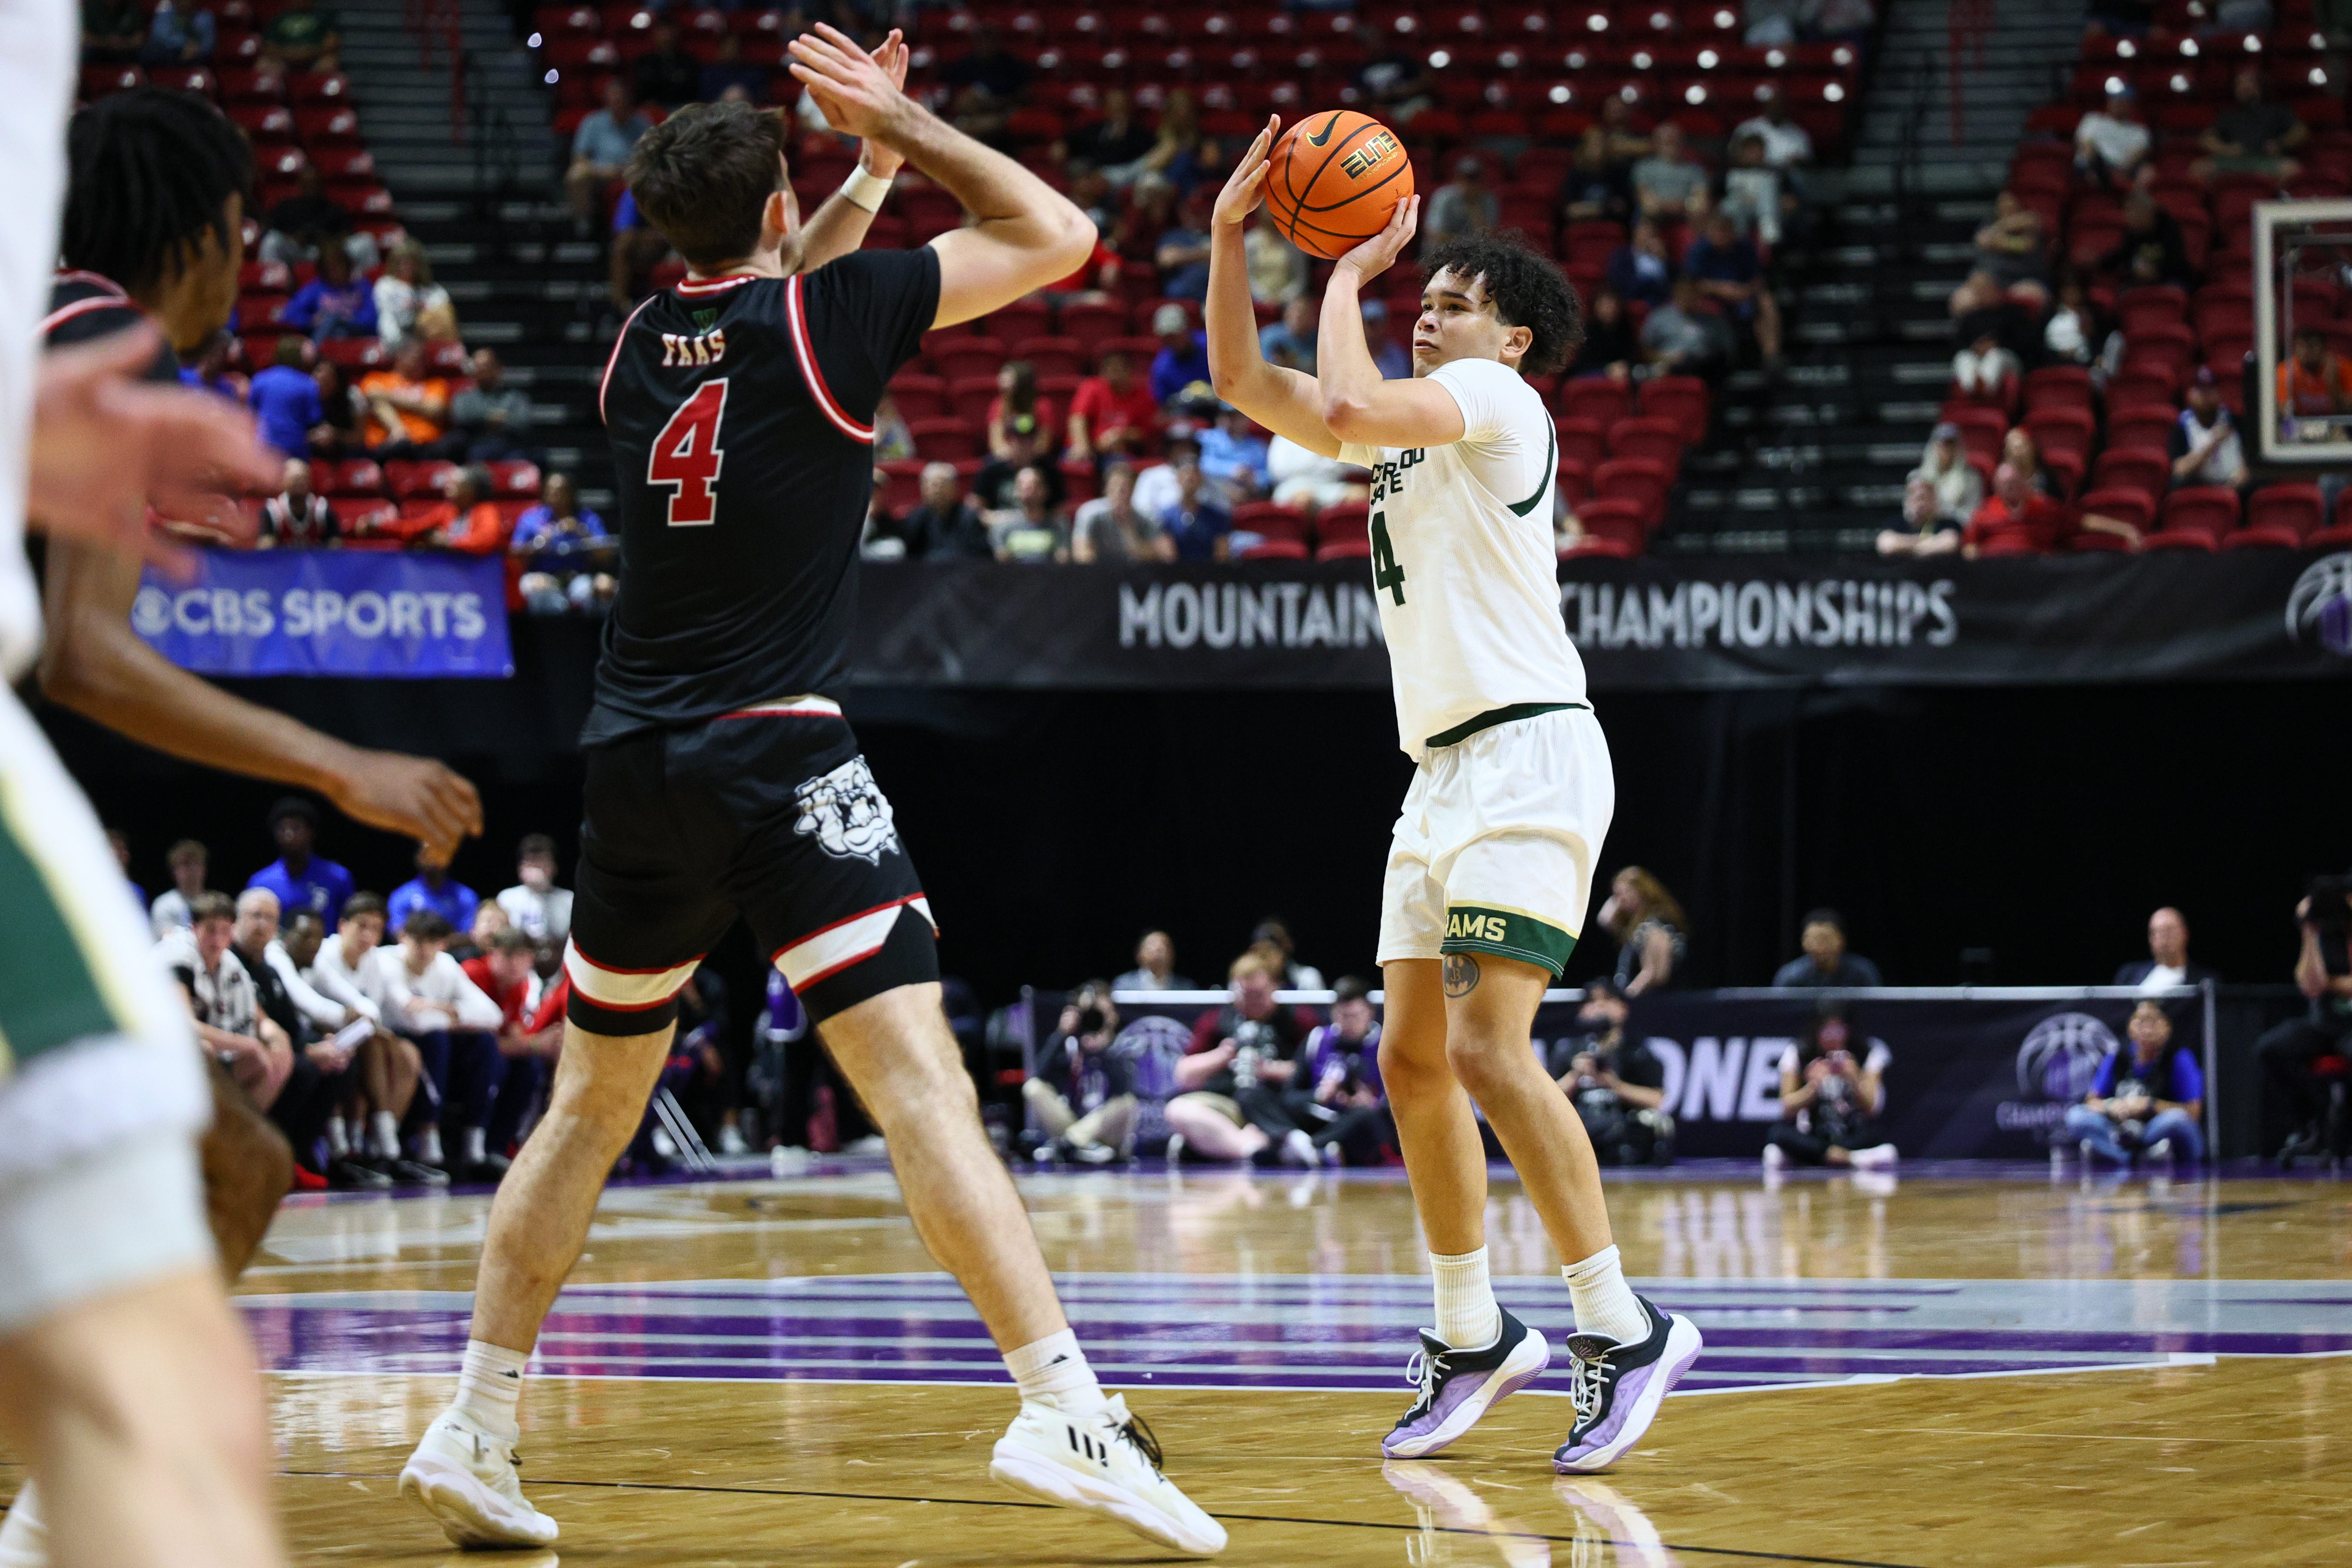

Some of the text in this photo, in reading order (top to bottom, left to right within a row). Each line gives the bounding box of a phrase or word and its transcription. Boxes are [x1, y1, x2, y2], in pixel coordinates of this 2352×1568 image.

[1340, 131, 1398, 180] ELITE
[661, 329, 726, 367] FAAS
[647, 377, 729, 527] 4
[1371, 511, 1406, 607] 4
[175, 587, 486, 640] CBS SPORTS
[1118, 579, 1958, 649] MOUNTAIN CHAMPIONSHIPS
